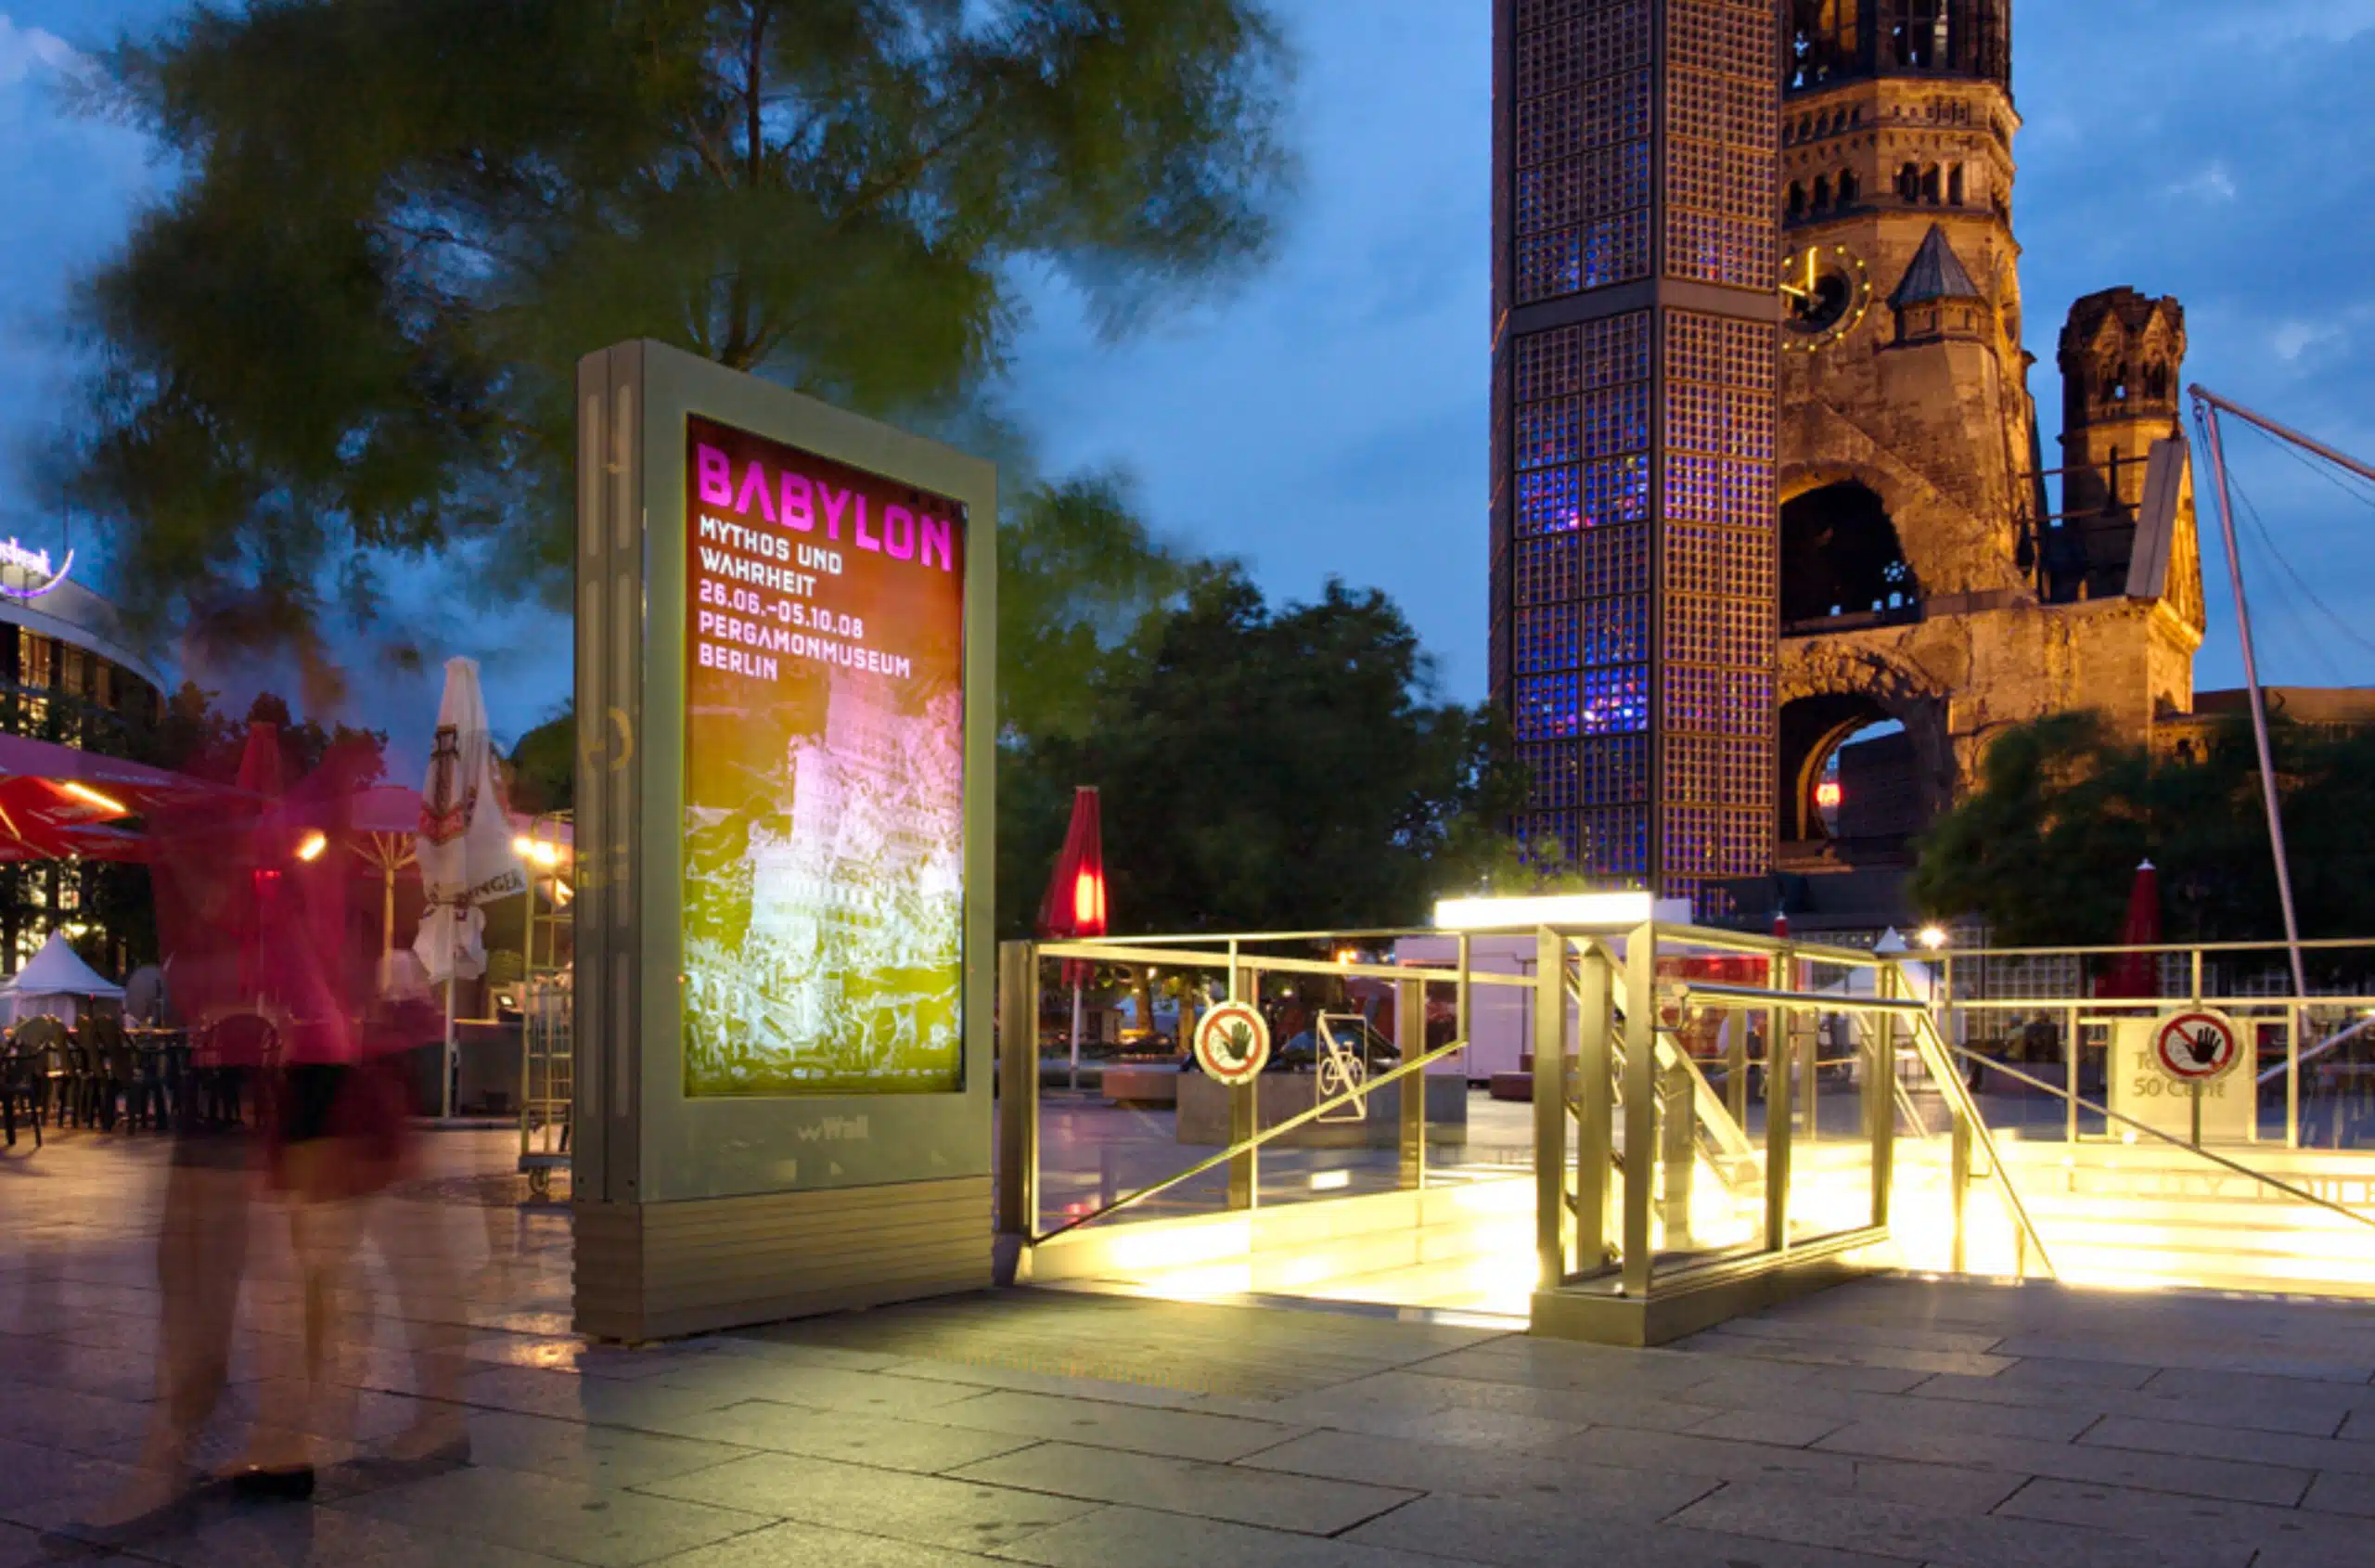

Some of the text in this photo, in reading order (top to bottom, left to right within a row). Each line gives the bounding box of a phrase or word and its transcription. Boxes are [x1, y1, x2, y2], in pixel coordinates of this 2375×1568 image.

[698, 443, 952, 572] BABYLON
[700, 514, 842, 575] MYTHOS UND
[700, 546, 816, 598] WAHRHEIT
[700, 579, 864, 639] 26.06.-05.10.08
[700, 610, 911, 678] PERGAMONMUSEUM
[700, 643, 777, 682] BERLIN
[2132, 1077, 2162, 1098] 50
